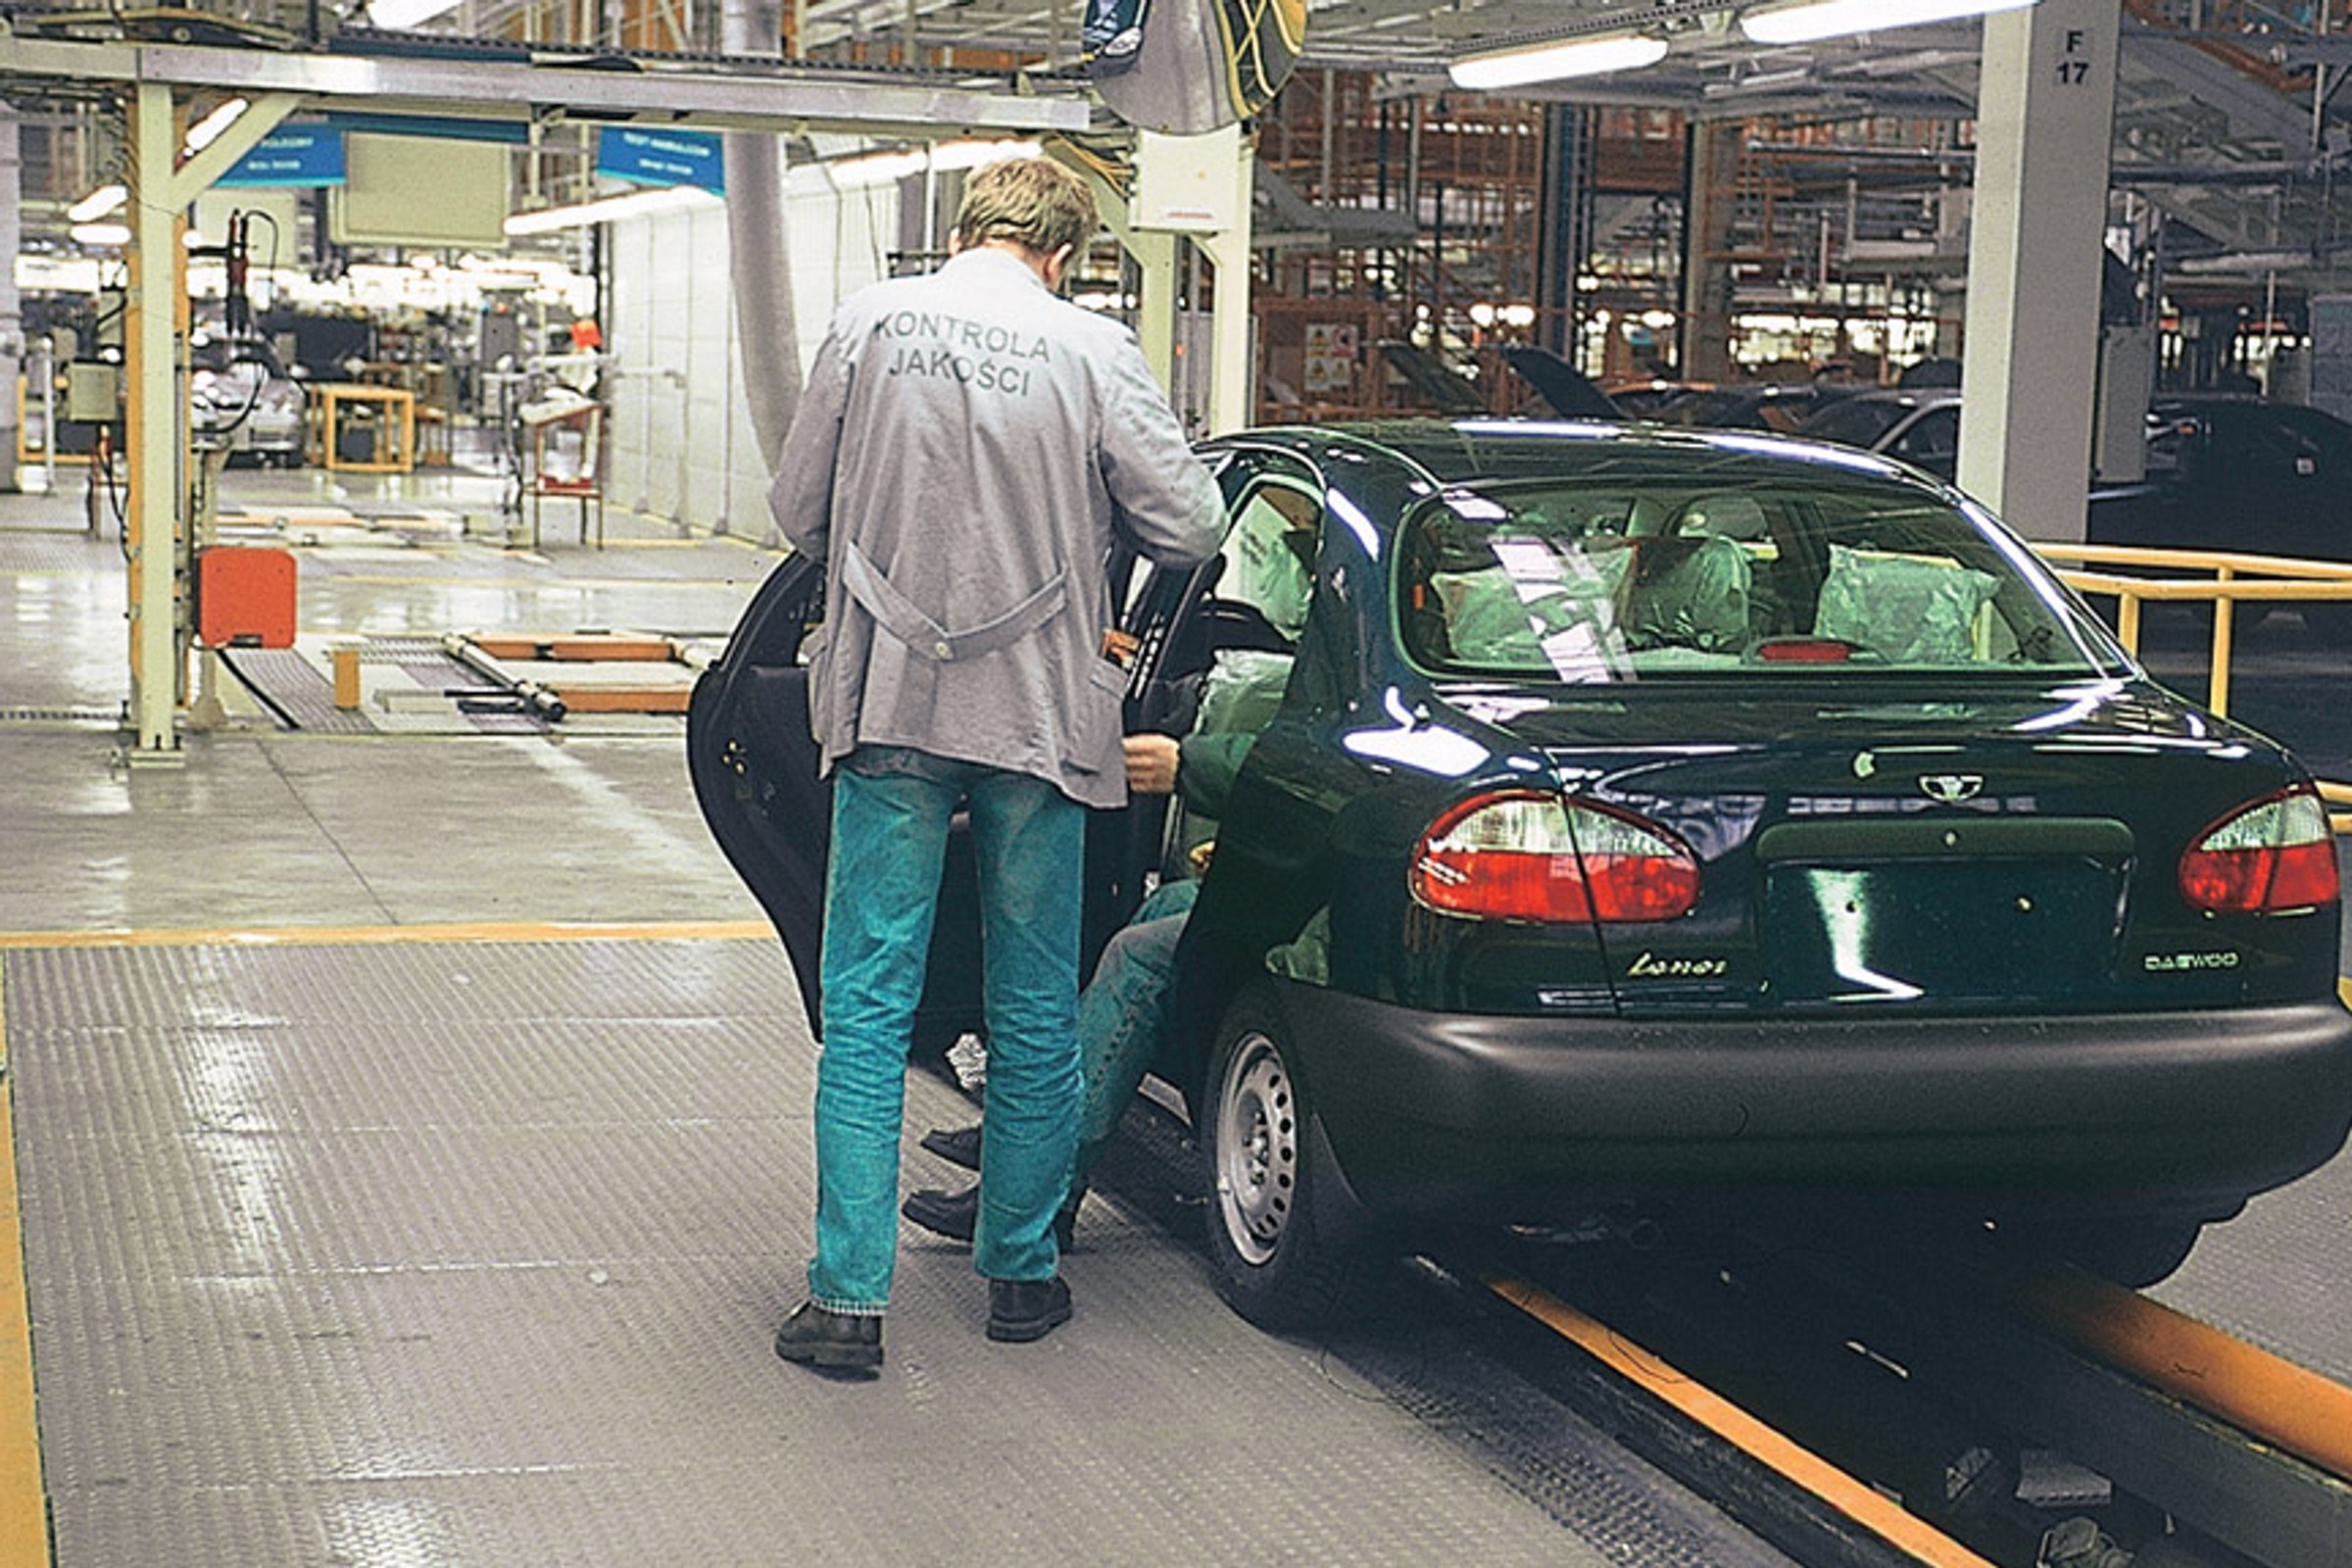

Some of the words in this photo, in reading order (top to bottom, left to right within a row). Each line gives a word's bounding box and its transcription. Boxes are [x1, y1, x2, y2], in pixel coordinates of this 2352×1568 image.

[2067, 29, 2083, 53] F
[2057, 61, 2089, 85] 17
[874, 310, 1050, 364] KONTROLA
[889, 349, 1030, 396] JAKOŚCI
